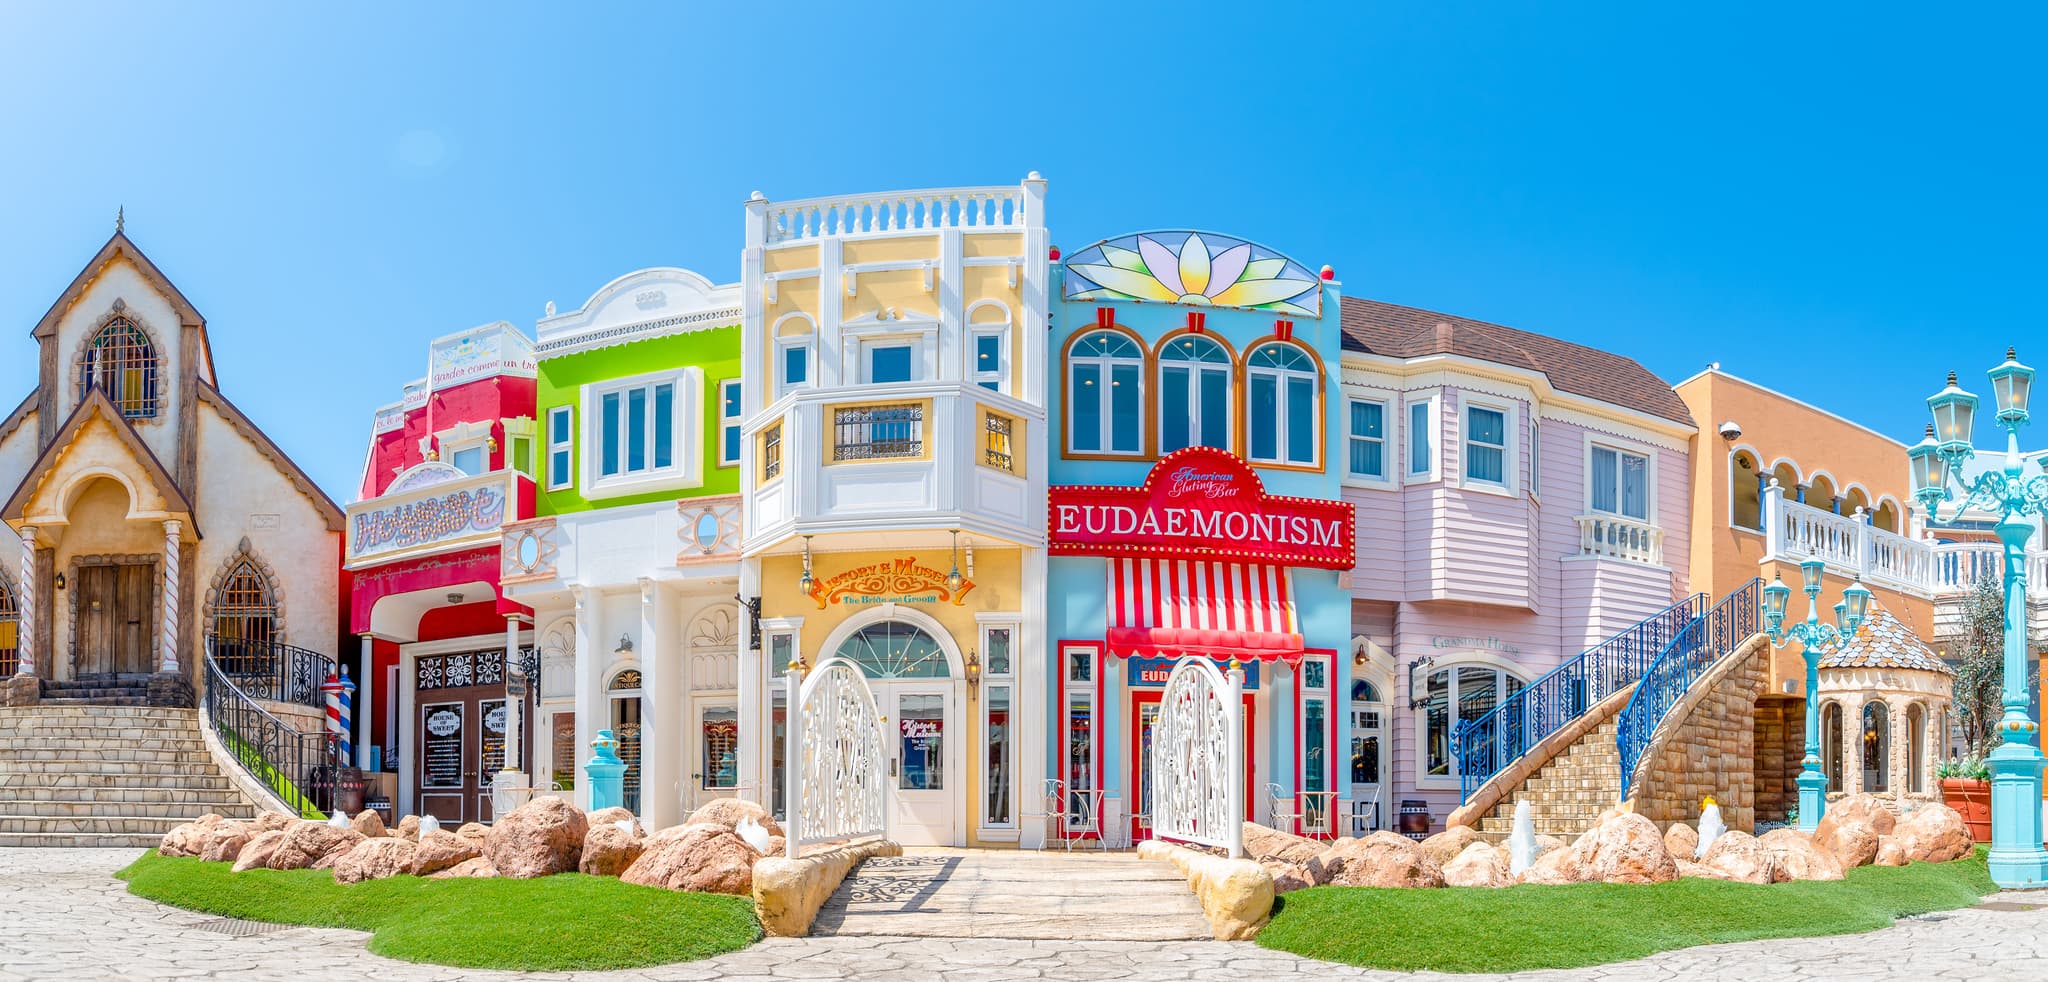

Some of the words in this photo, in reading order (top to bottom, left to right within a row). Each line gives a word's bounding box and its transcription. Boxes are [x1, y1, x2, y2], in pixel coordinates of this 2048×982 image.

[1170, 466, 1234, 482] American
[1204, 481, 1240, 499] Bar
[1056, 504, 1342, 548] EUDAEMONISM
[843, 596, 859, 604] The
